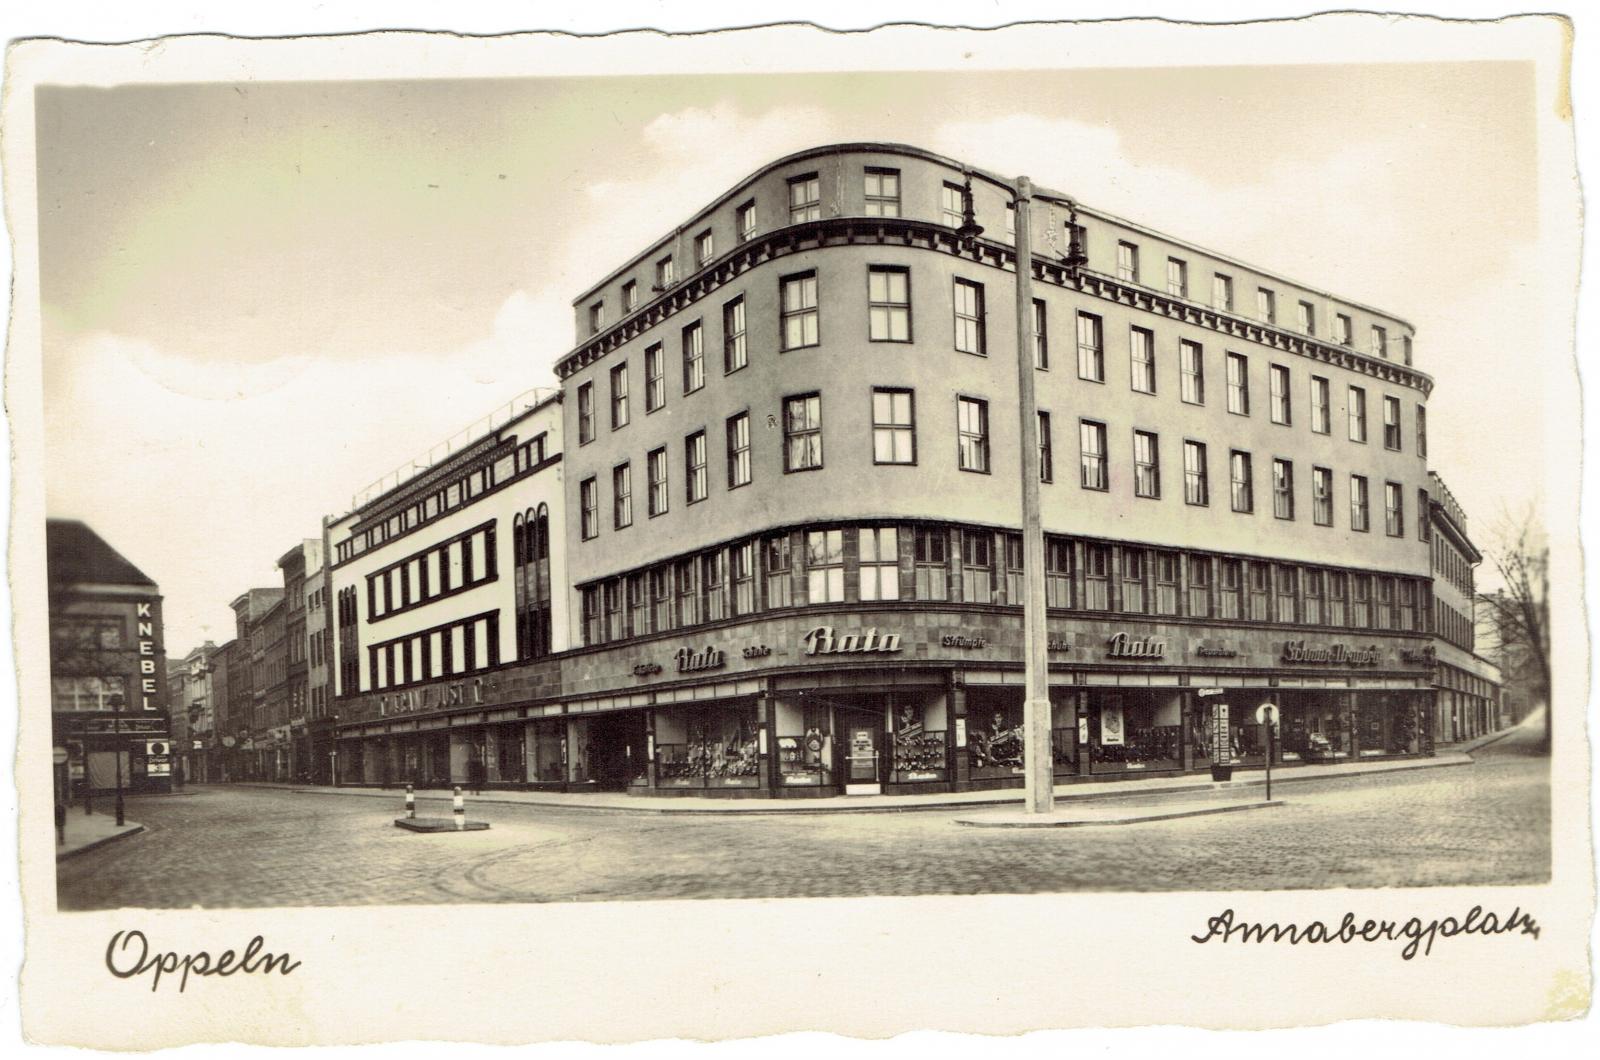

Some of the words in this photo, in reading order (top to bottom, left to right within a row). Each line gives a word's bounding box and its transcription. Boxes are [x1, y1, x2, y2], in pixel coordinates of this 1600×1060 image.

[803, 625, 904, 656] Bata
[1108, 631, 1168, 658] Bata
[136, 602, 157, 712] KNEBEL
[674, 645, 726, 673] Bata
